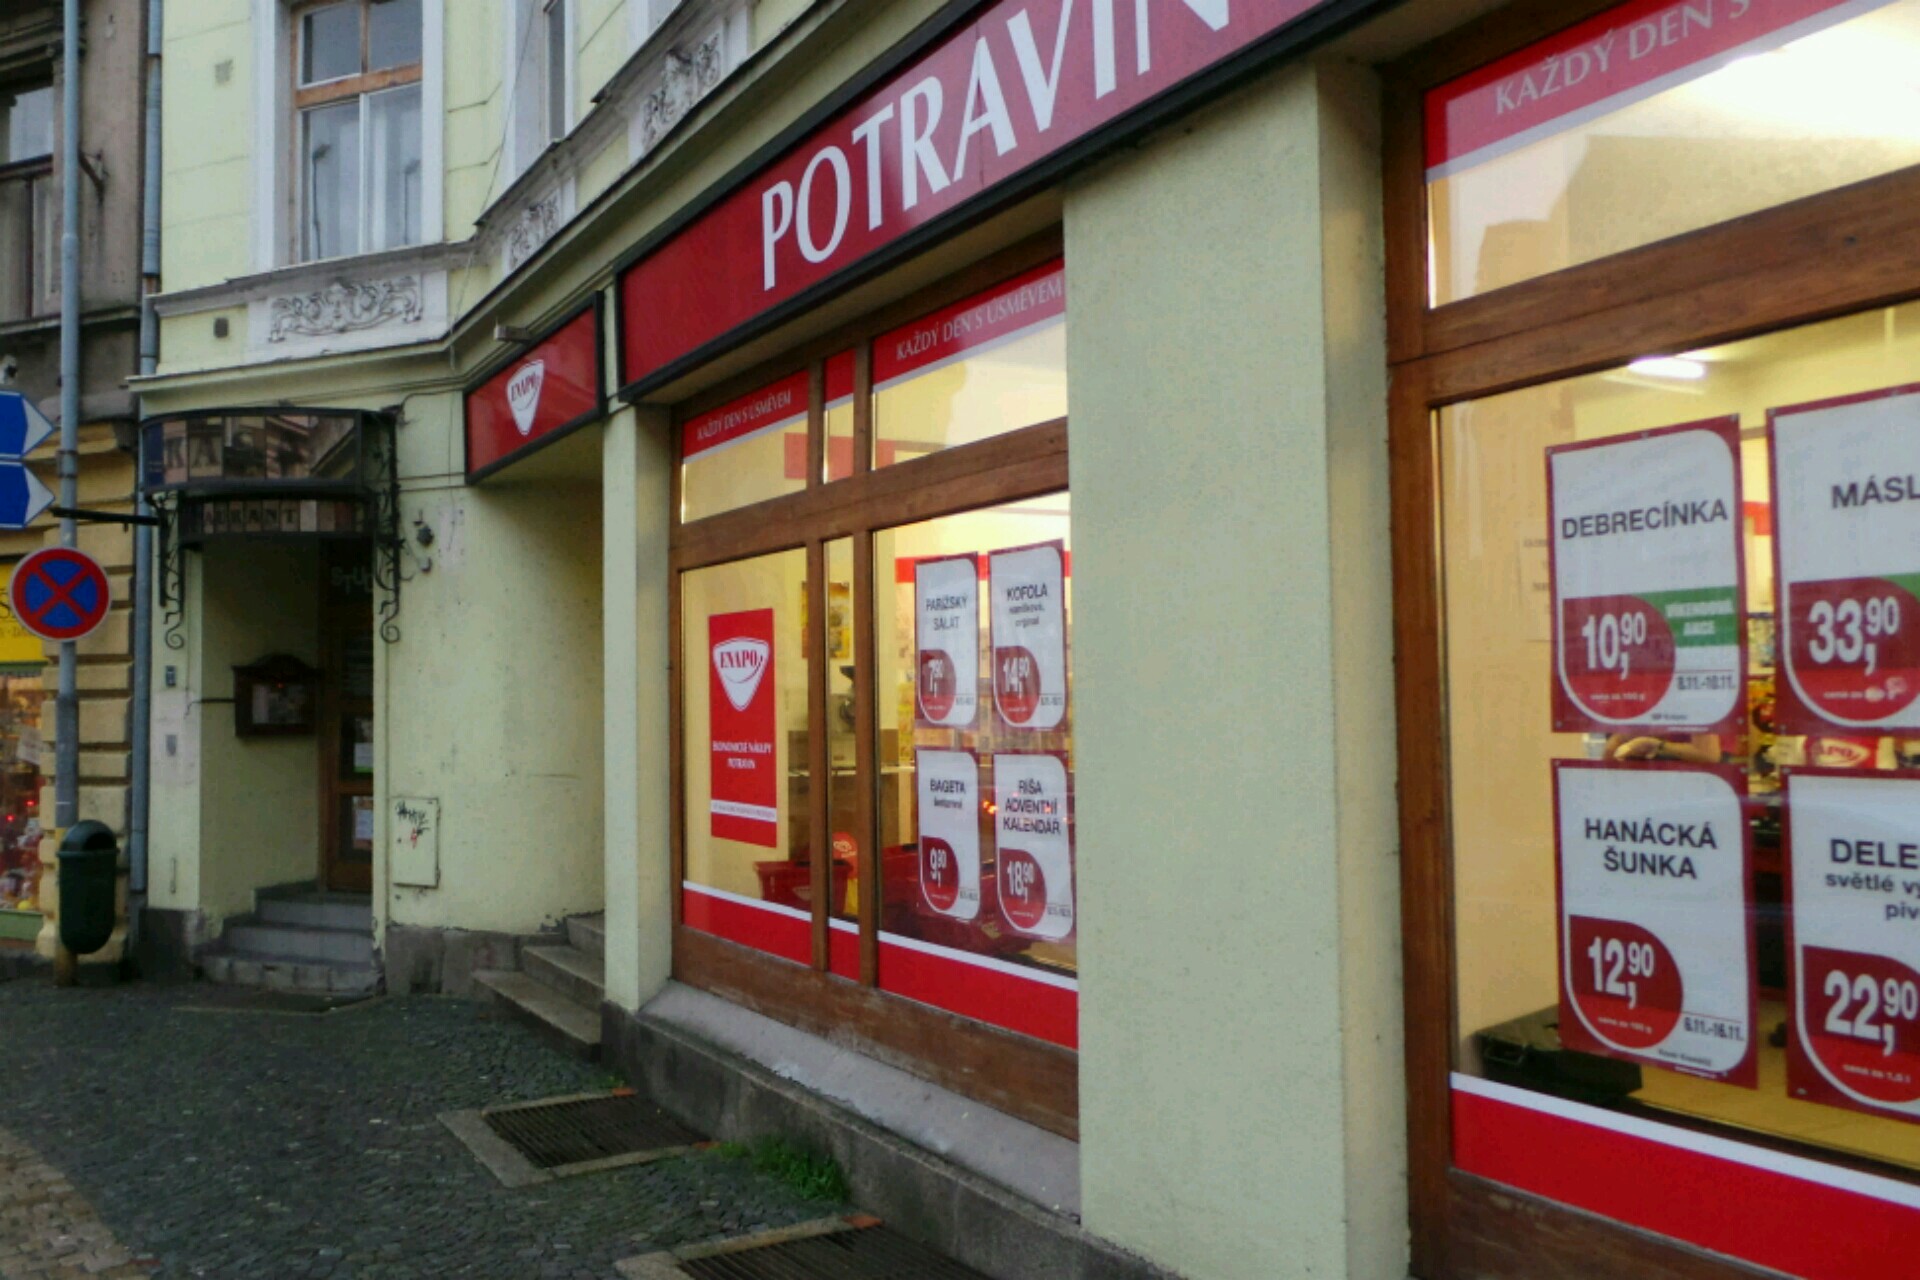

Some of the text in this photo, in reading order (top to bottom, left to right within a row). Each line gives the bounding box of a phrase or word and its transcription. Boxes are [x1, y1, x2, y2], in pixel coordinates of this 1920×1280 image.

[1494, 29, 1614, 115] KAŽDÝ
[1628, 0, 1713, 60] DEN
[896, 277, 1063, 361] KAŽDÝ DEN S ÚSMĚVEM
[1831, 474, 1920, 510] MÁSL
[1561, 498, 1728, 540] DEBRECÍNKA
[1006, 582, 1049, 602] KOFOLA
[930, 778, 966, 794] BAGETA
[1584, 816, 1718, 850] HANÁCKÁ
[1603, 847, 1698, 880] ŠUNKA
[1830, 838, 1919, 870] DELE
[1825, 871, 1895, 893] světlé
[1884, 903, 1920, 921] piv
